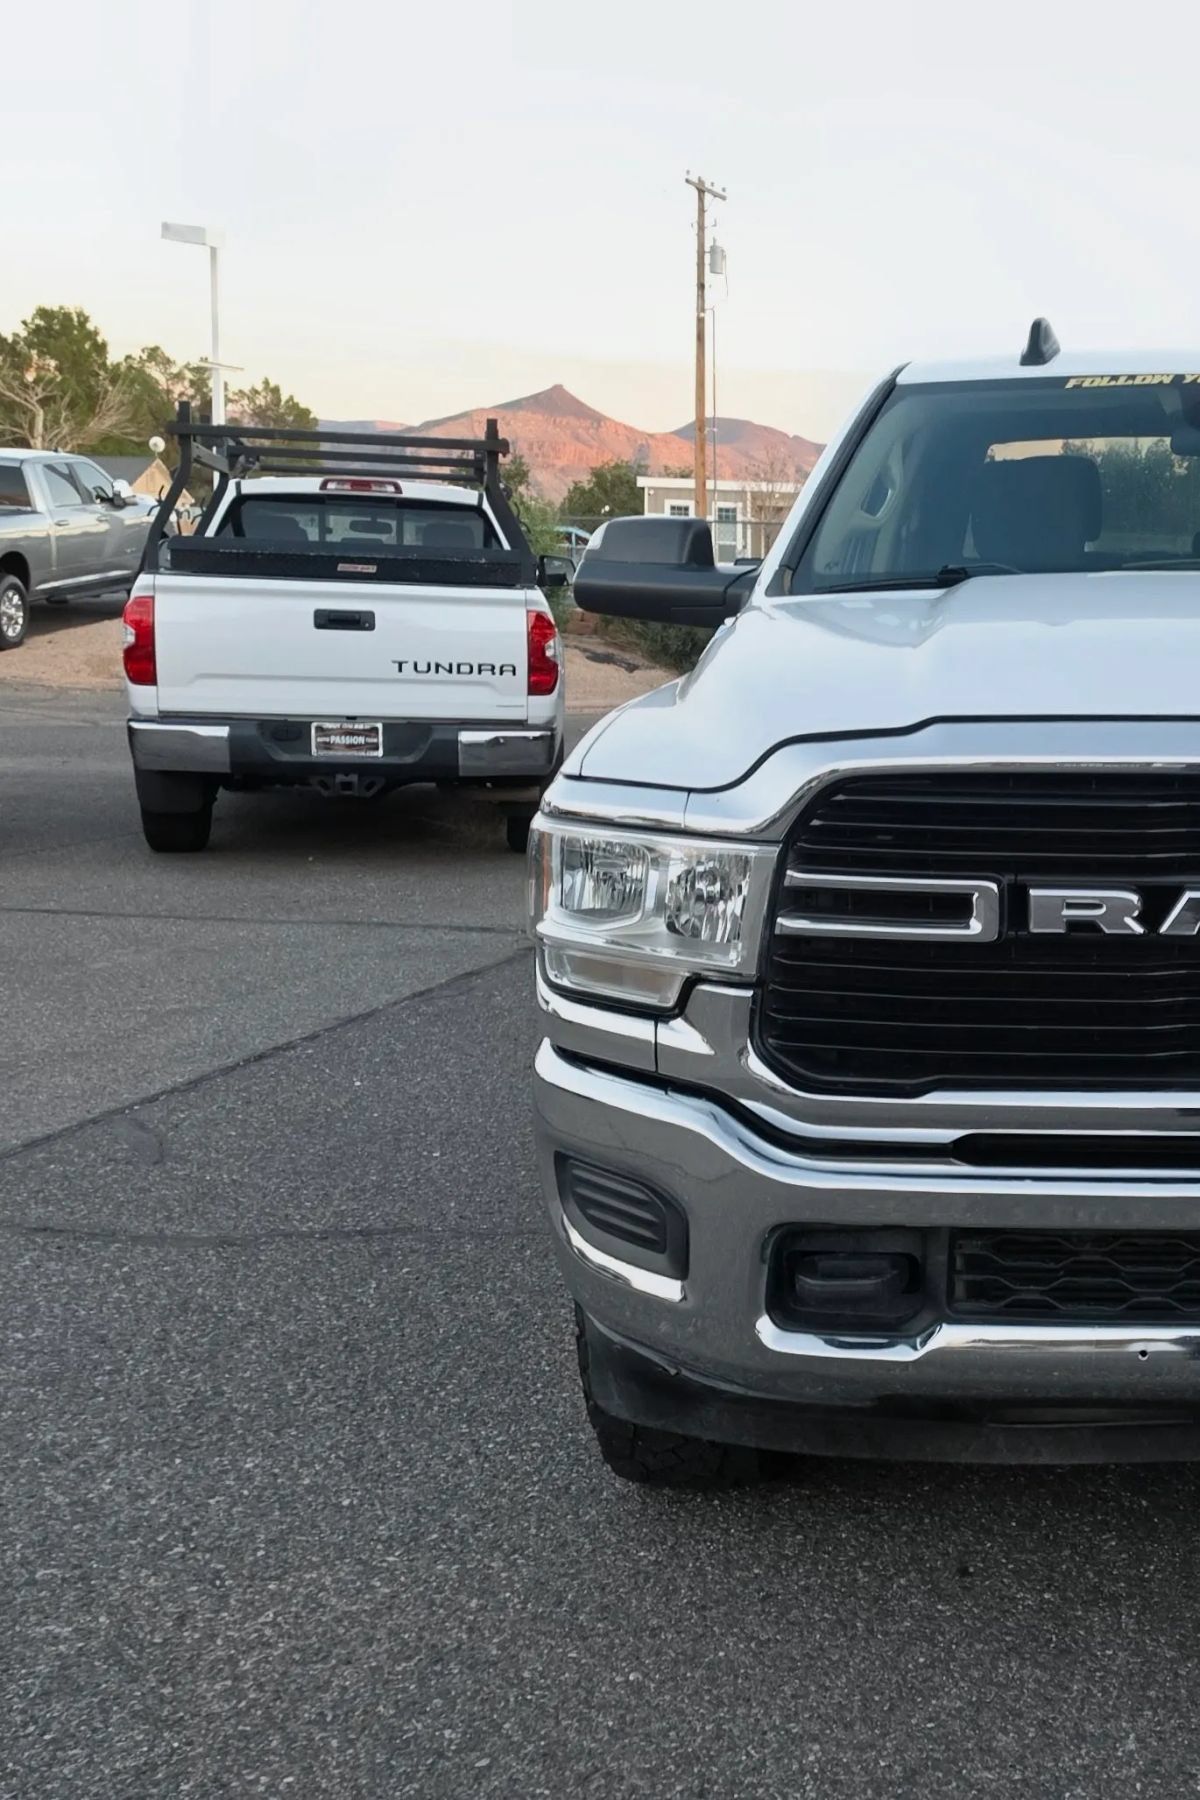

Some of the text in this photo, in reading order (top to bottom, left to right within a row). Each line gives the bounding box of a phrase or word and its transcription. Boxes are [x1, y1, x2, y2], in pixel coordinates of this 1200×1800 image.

[1064, 374, 1175, 389] FOLLOW
[391, 659, 517, 677] TUNDRA
[330, 735, 365, 745] PASSION
